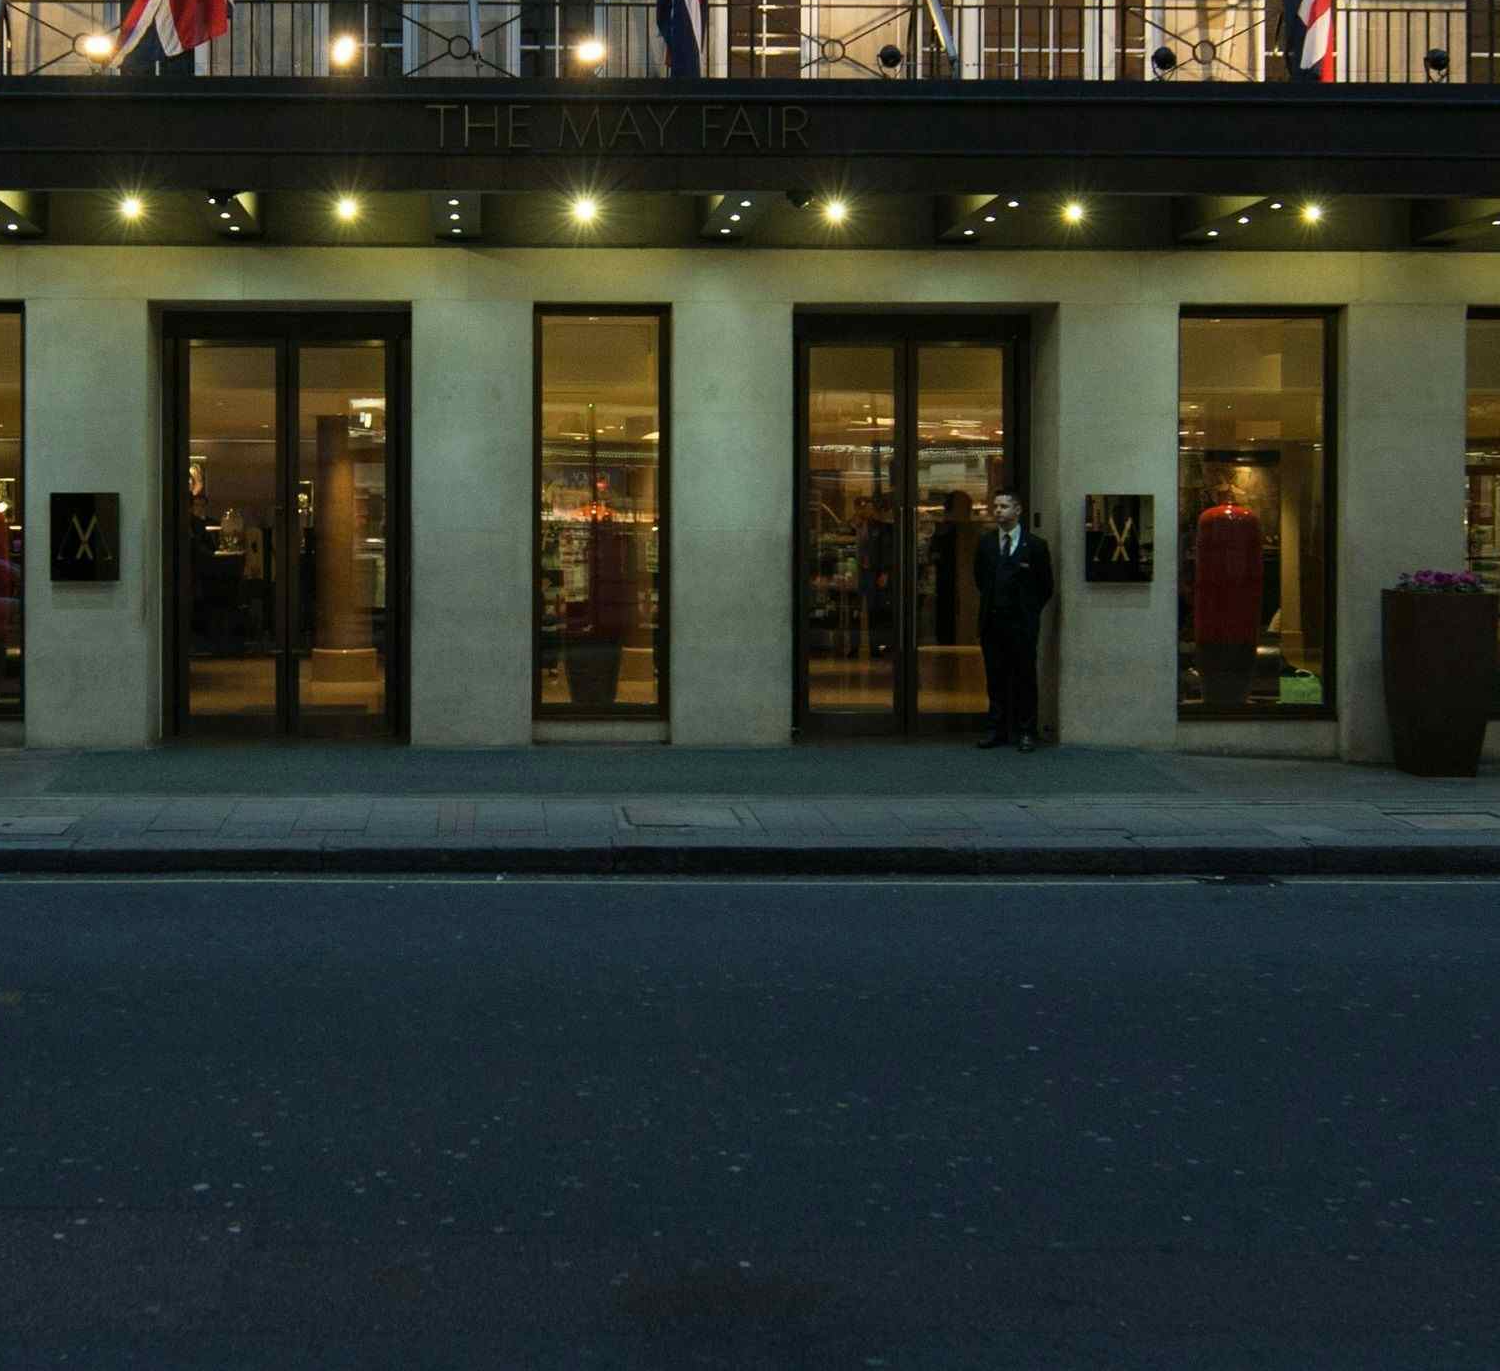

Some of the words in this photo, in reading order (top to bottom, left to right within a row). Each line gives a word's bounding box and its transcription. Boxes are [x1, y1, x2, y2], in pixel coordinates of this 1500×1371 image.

[423, 102, 533, 149] THE
[557, 102, 680, 149] MAY
[701, 102, 812, 149] FAIR
